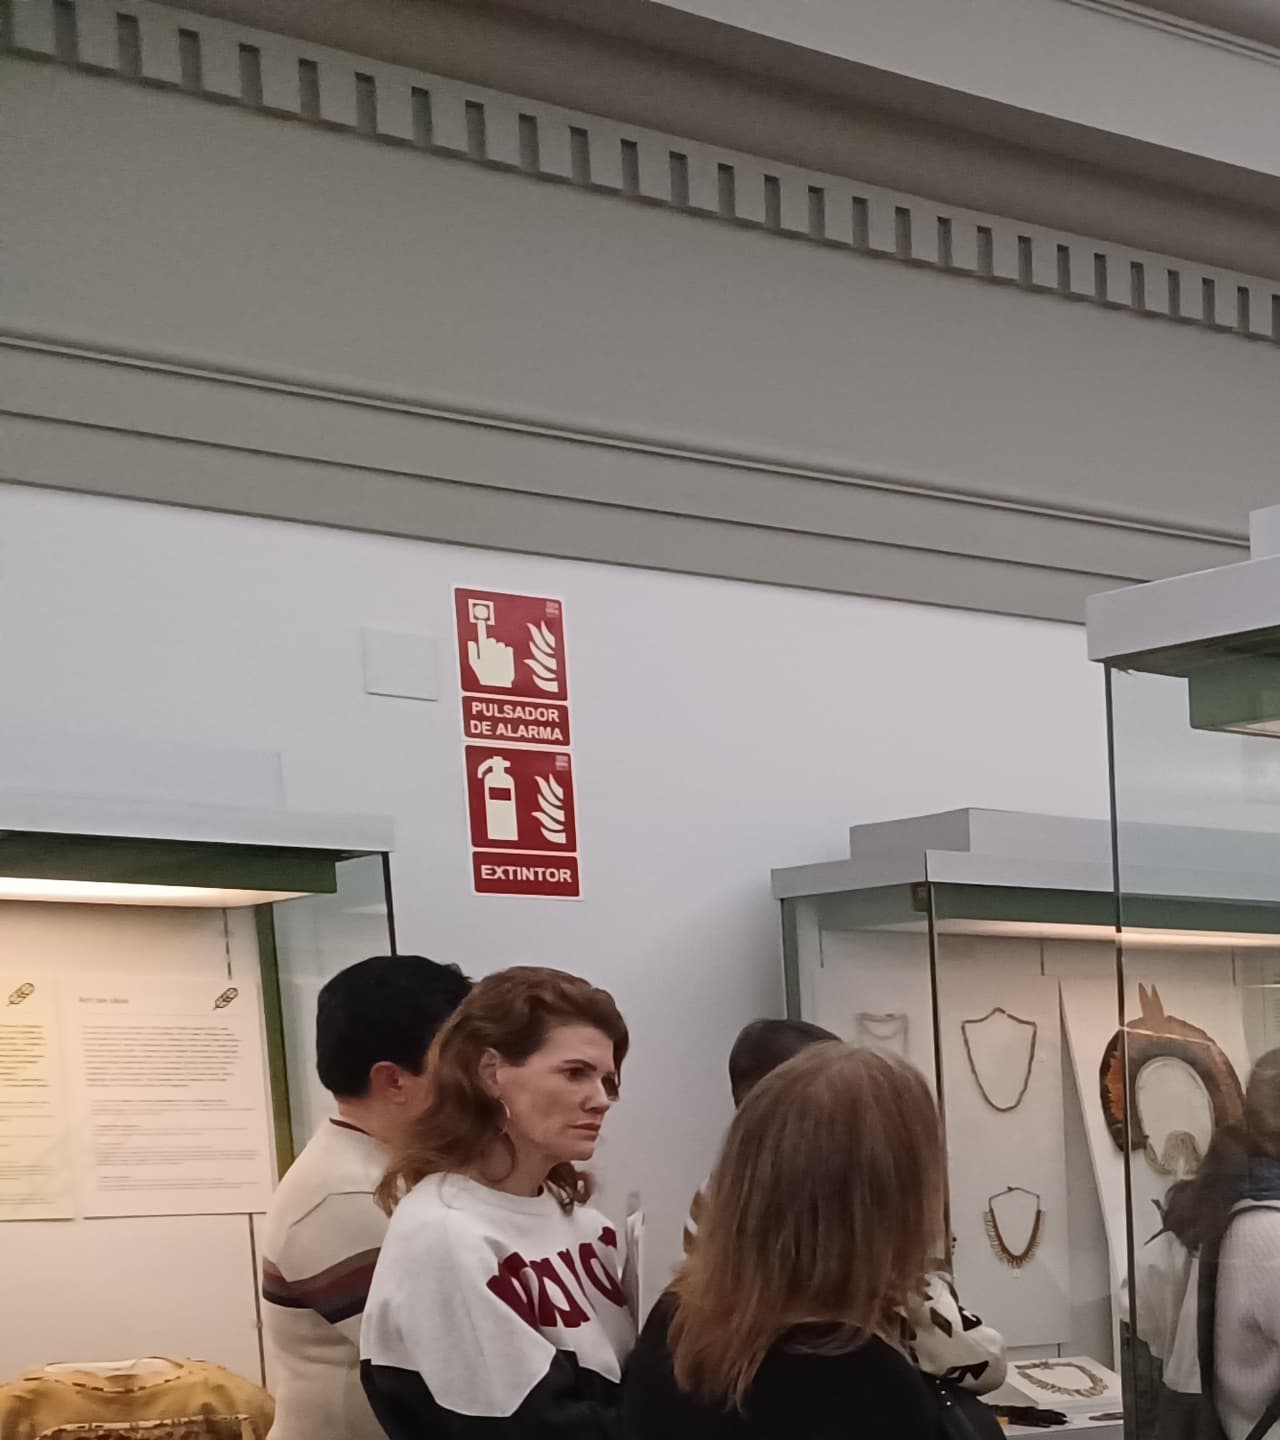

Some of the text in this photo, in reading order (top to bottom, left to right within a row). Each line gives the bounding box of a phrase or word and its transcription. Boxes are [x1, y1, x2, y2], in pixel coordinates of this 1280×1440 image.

[471, 701, 560, 722] PULSADOR
[469, 719, 563, 741] DE ALARMA
[480, 864, 573, 883] EXTINTOR
